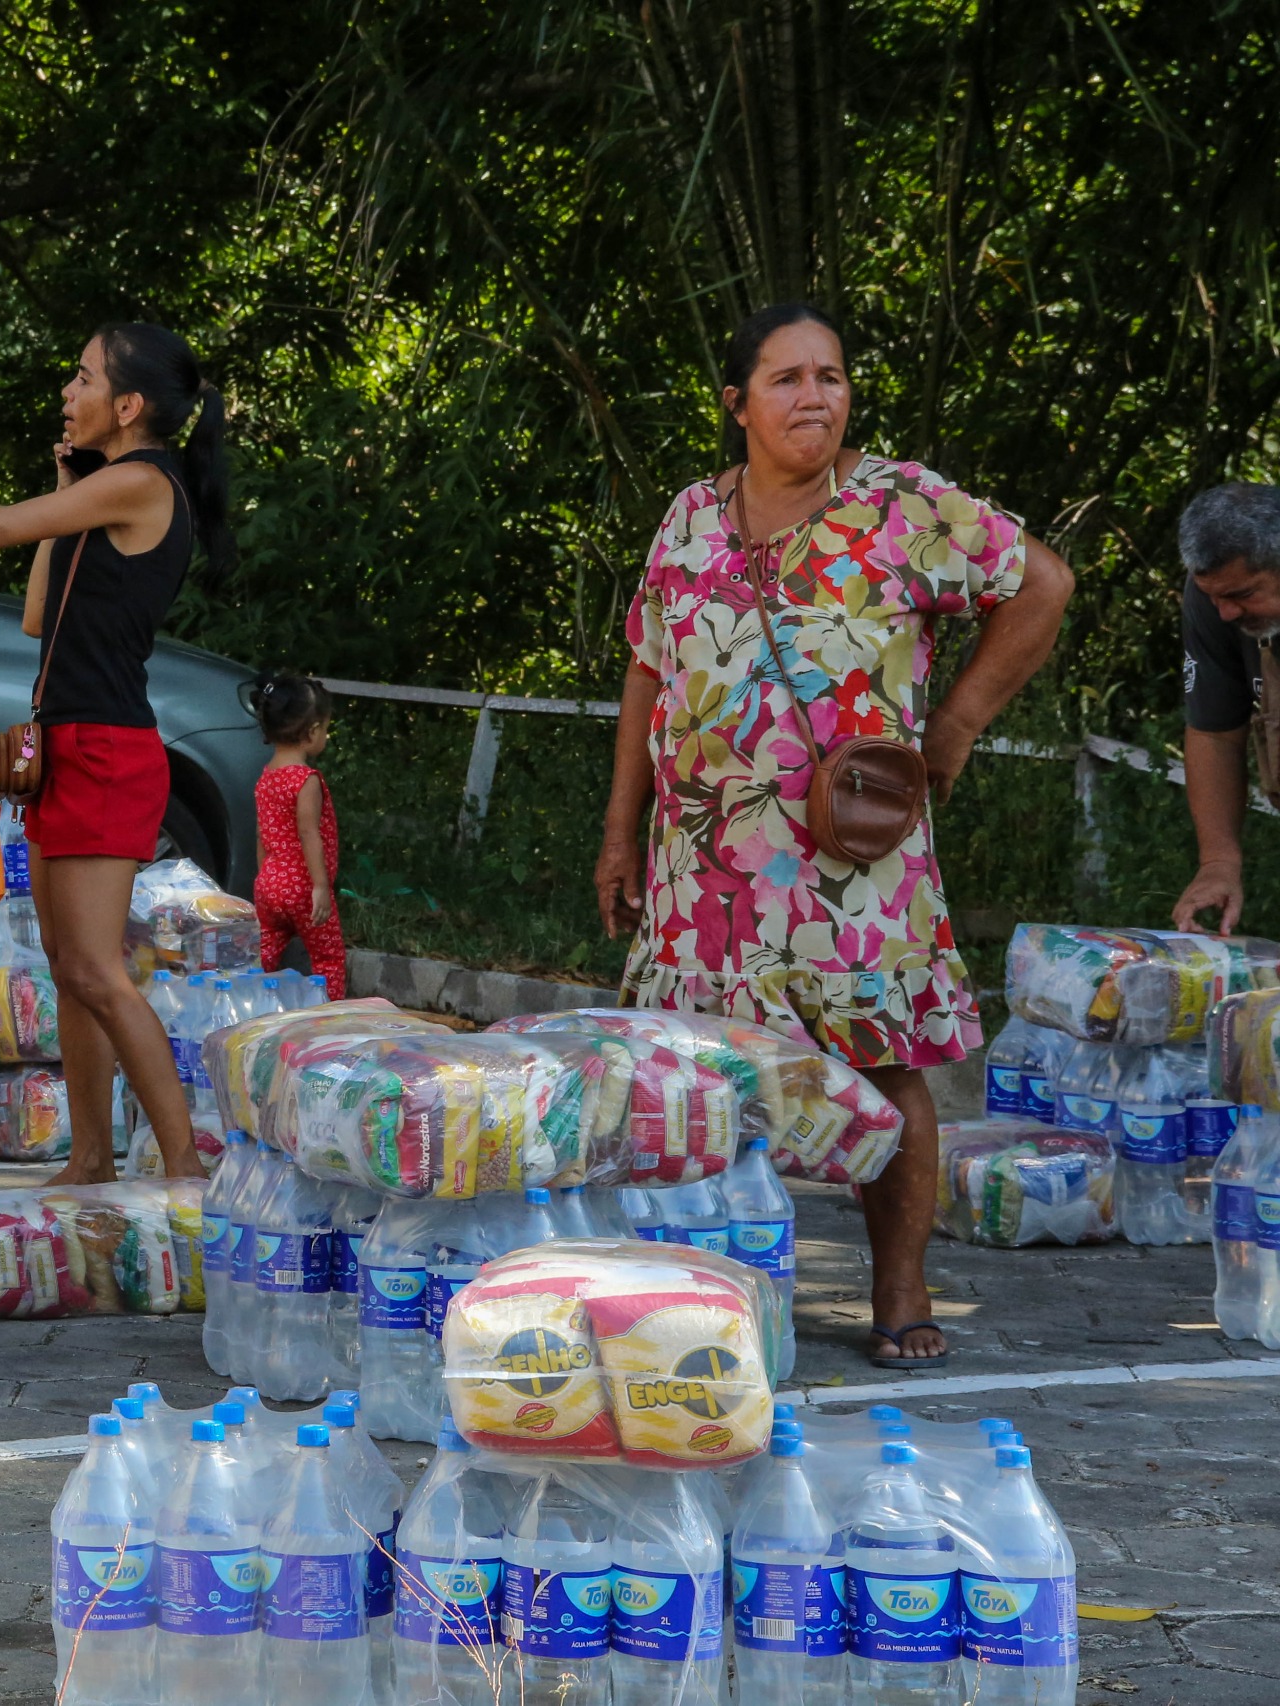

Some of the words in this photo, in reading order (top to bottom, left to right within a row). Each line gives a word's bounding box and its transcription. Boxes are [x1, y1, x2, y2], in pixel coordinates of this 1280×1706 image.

[419, 1113, 430, 1170] Nordestino
[742, 1231, 768, 1244] TOYA
[385, 1278, 414, 1292] TOYA
[101, 1561, 138, 1580] TOYA
[617, 1581, 649, 1606] TOYA
[889, 1590, 930, 1610] TOYA
[973, 1589, 1010, 1612] TOYA
[104, 1612, 127, 1620] MINERAL
[226, 1615, 239, 1624] ÁGUA
[660, 1616, 671, 1626] 2L
[941, 1617, 949, 1626] 2L
[1024, 1622, 1034, 1631] 2L
[572, 1640, 586, 1648] ÁGUA
[635, 1640, 659, 1649] NATURAL
[876, 1643, 892, 1651] ÁGUA
[977, 1645, 997, 1653] INERAL
[997, 1648, 1023, 1656] NATURAL
